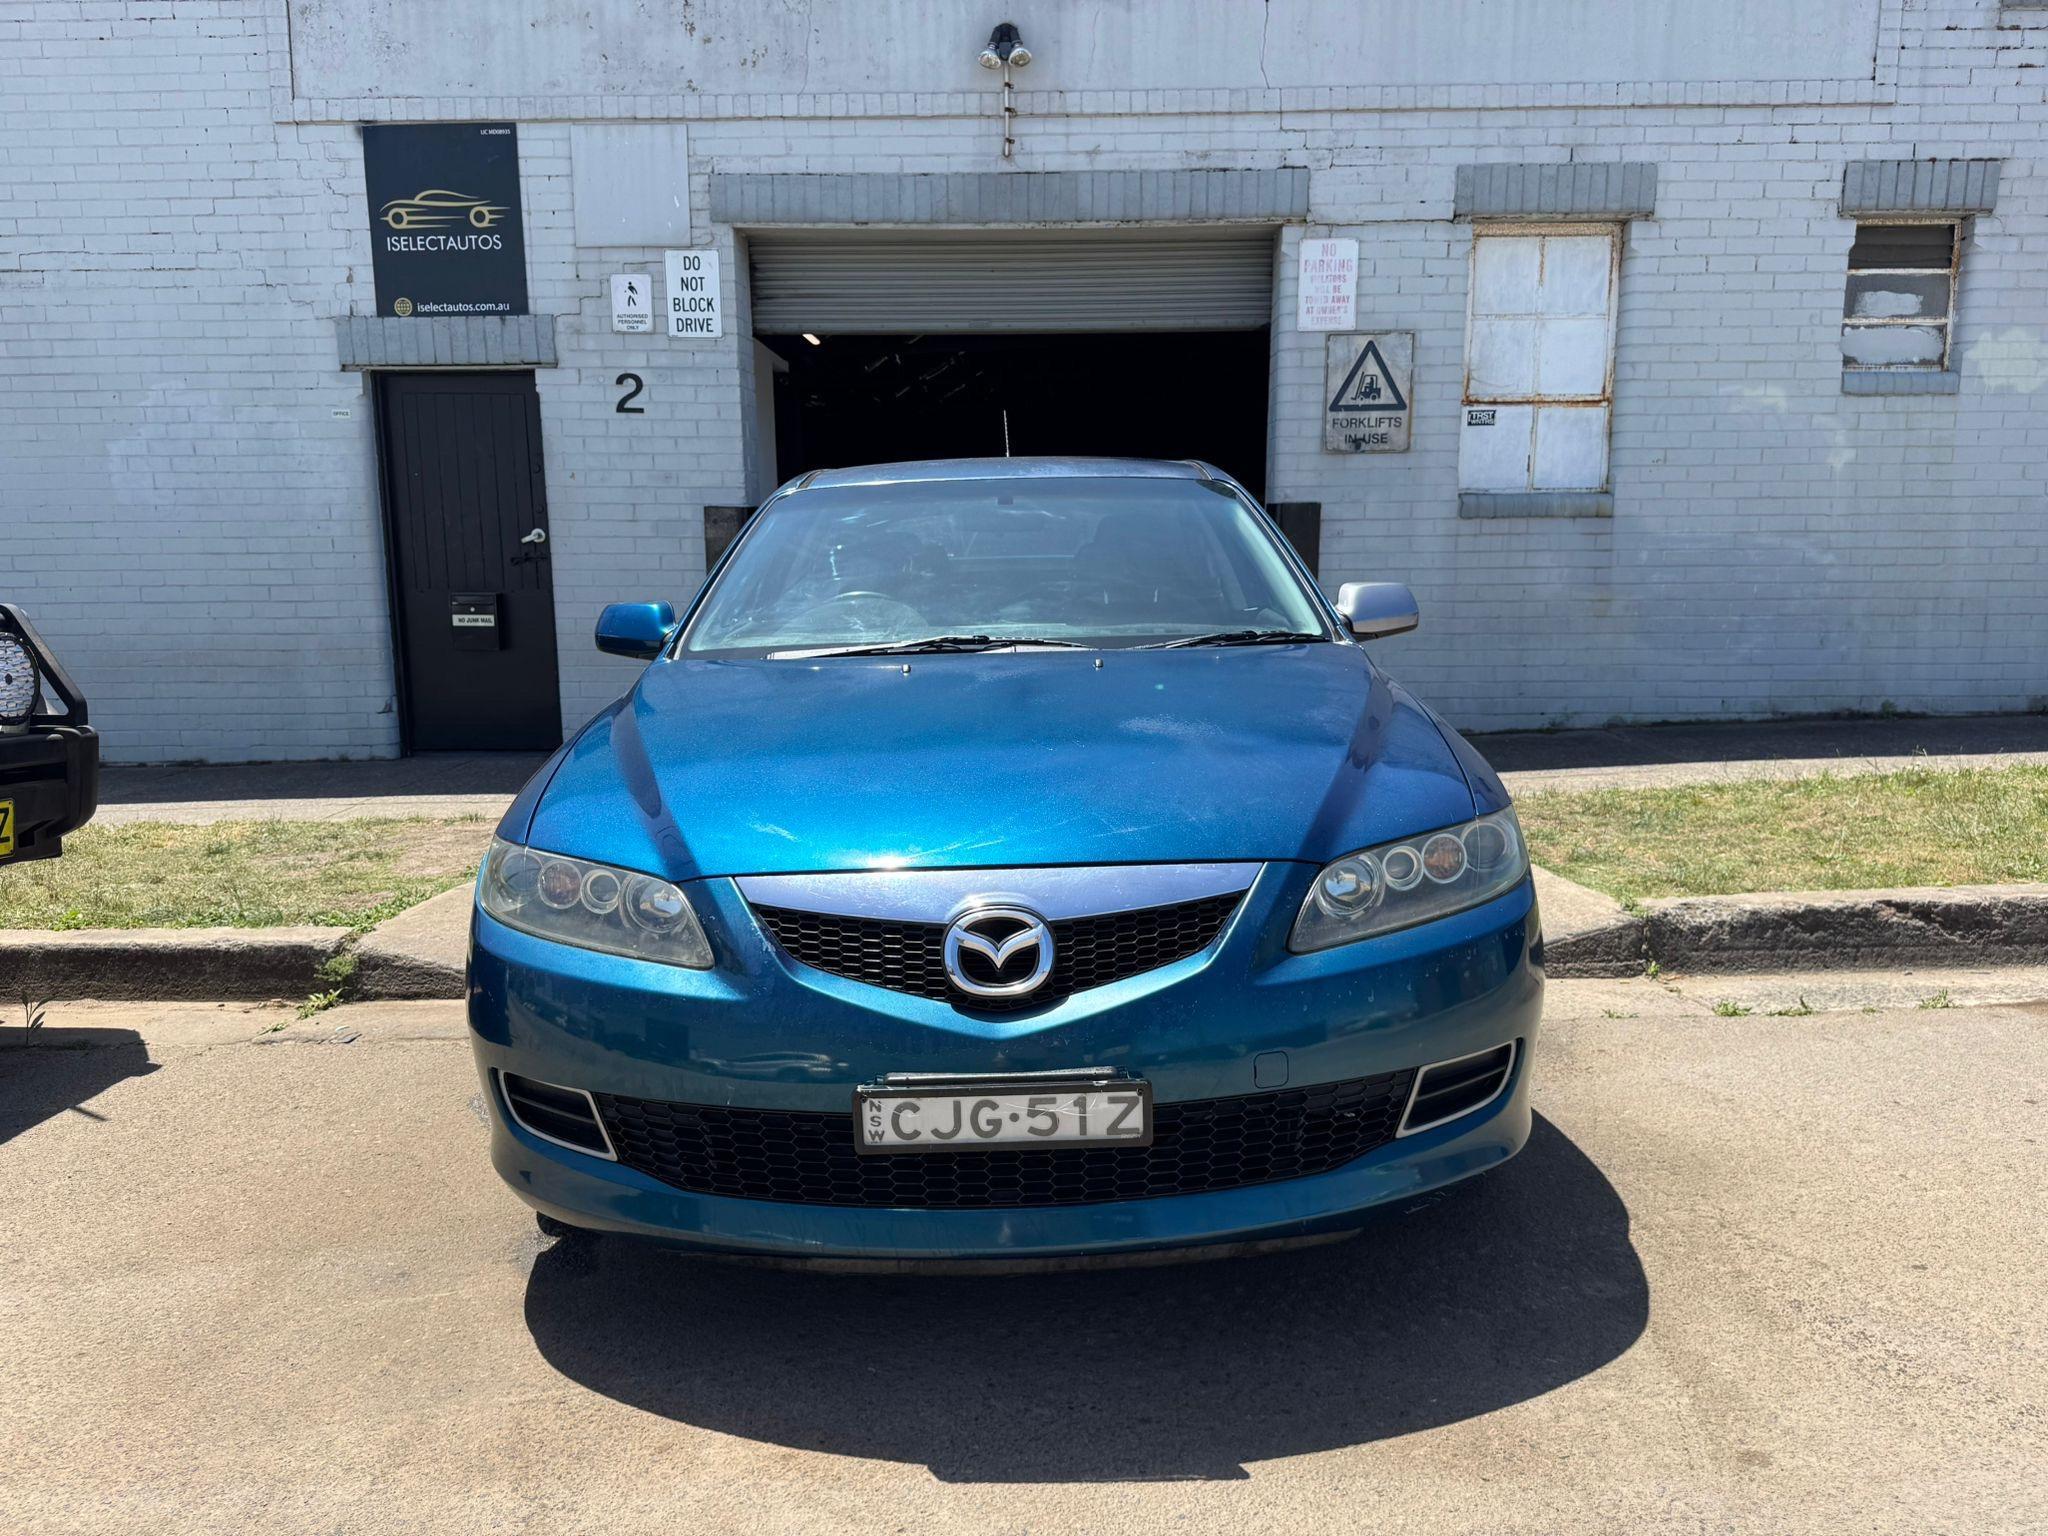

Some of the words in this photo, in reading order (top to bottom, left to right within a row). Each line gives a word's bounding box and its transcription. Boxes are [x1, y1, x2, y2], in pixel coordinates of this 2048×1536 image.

[387, 234, 502, 252] ISELECTAUTOS
[1321, 243, 1337, 257] NO
[683, 255, 701, 271] DO
[1304, 259, 1353, 273] PARKING
[680, 276, 705, 292] NOT
[1332, 285, 1342, 294] BE
[673, 297, 715, 313] BLOCK
[1331, 295, 1351, 304] AWAY
[417, 301, 510, 313] iselectautos.com.au
[1306, 306, 1314, 315] AT
[676, 317, 714, 333] DRIVE
[615, 372, 645, 414] 2
[1332, 416, 1402, 429] FORKLIFTS
[1344, 433, 1358, 445] IN
[1361, 433, 1388, 444] USE
